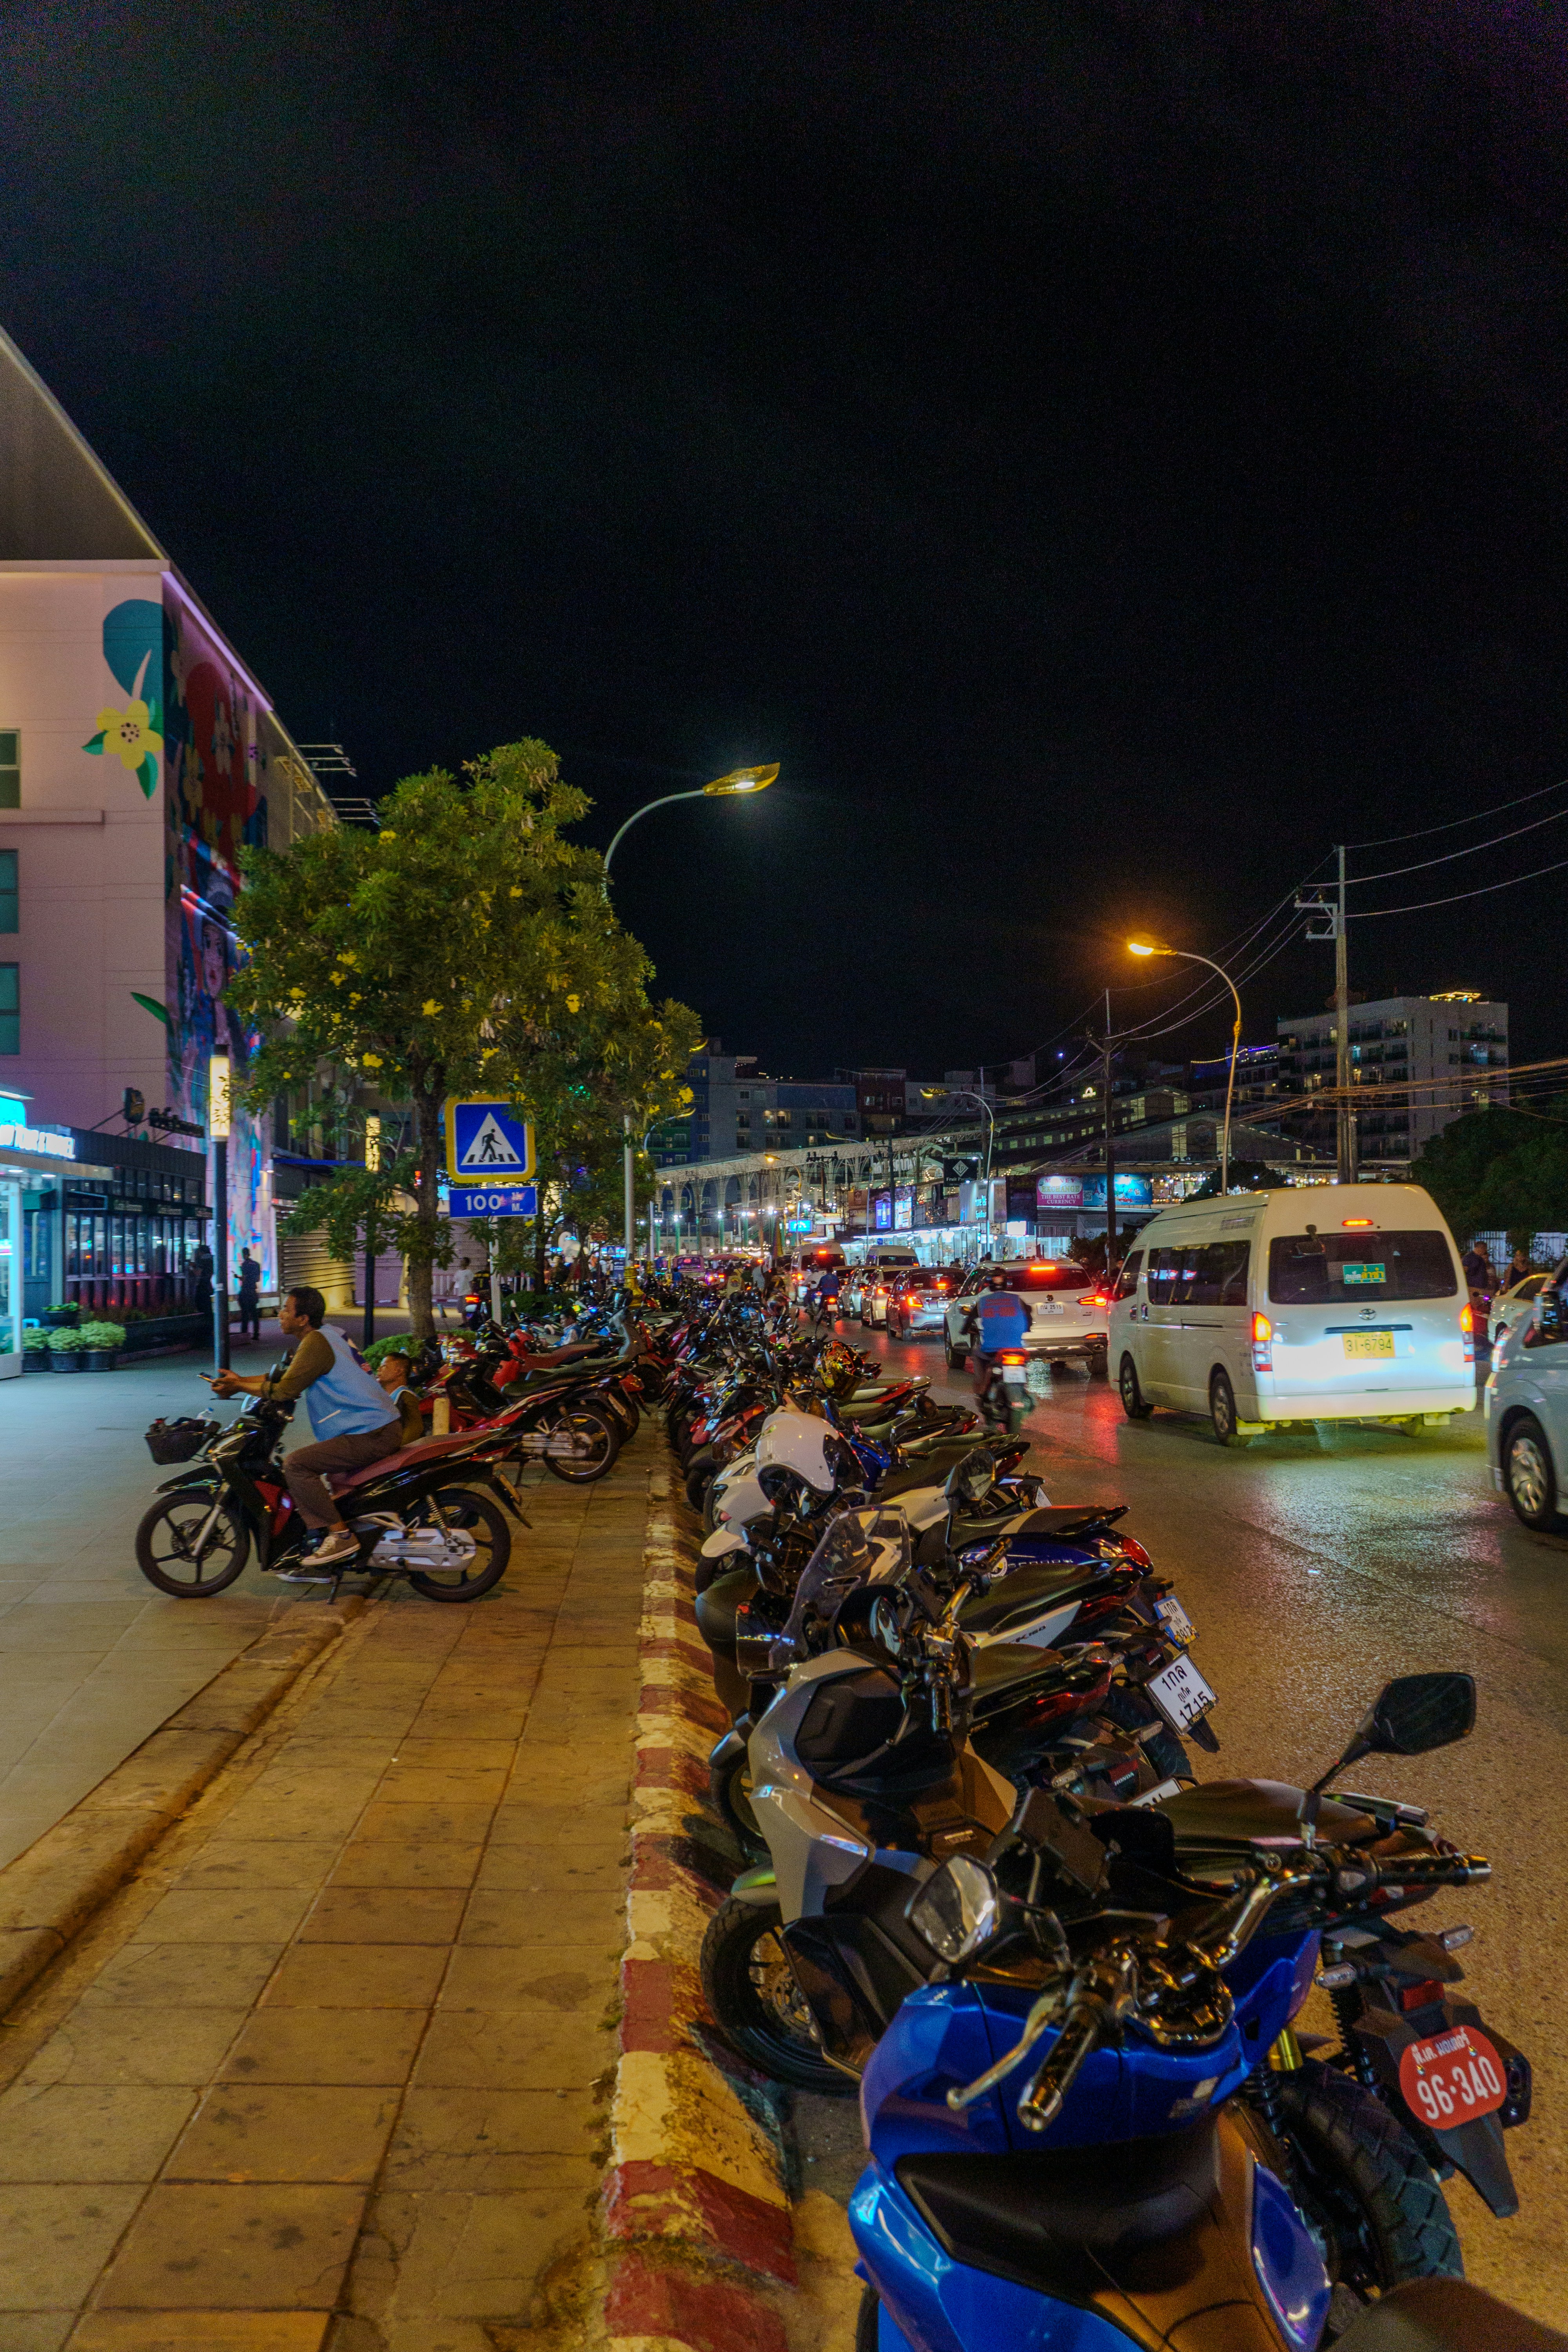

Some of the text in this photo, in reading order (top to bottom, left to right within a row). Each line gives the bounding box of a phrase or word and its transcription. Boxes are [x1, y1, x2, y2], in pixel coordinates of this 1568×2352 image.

[465, 1195, 501, 1211] 100
[1346, 1338, 1391, 1351] 31-6794
[1161, 1665, 1187, 1691] 1กล
[1180, 1690, 1210, 1724] 1715
[1114, 1772, 1134, 1786] HONDA
